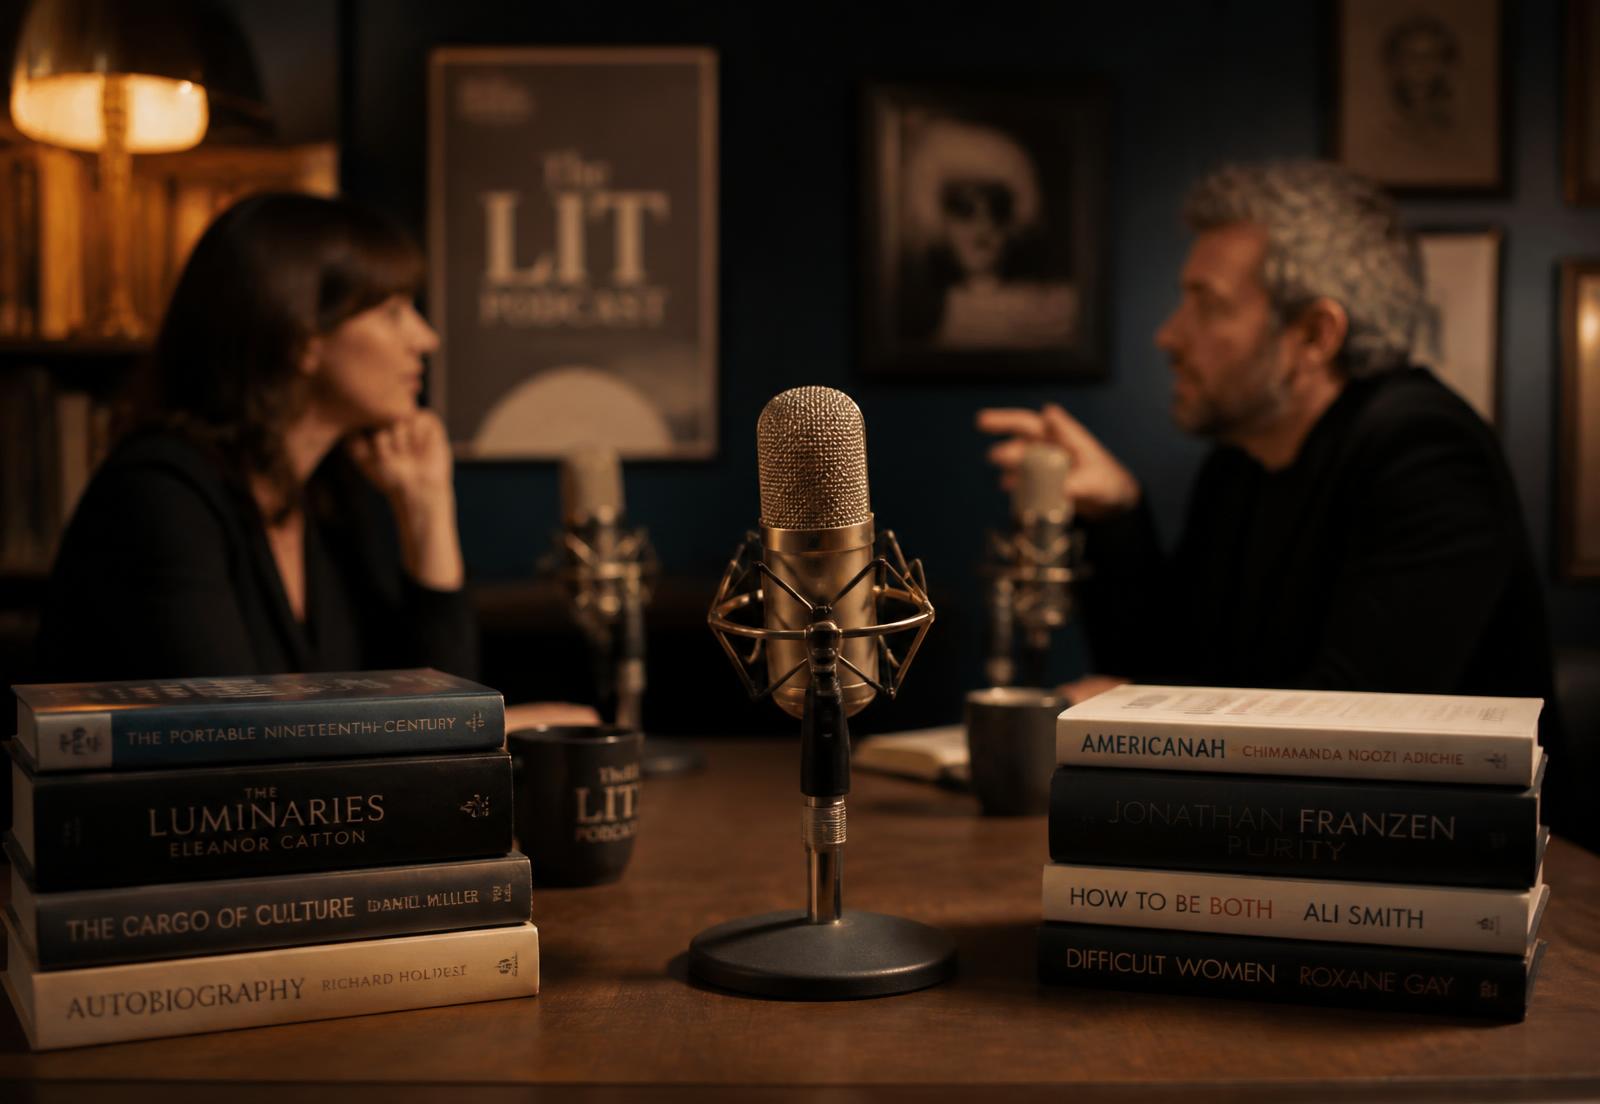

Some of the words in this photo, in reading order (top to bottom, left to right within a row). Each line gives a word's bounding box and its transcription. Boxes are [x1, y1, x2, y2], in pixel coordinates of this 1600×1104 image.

[480, 189, 670, 285] LIT
[128, 731, 161, 745] THE
[169, 727, 256, 745] PORTABLE
[1081, 733, 1225, 759] AMERICANAH
[1348, 750, 1397, 763] NGOZI
[1402, 751, 1465, 766] ADICHIE
[243, 786, 278, 798] THE
[575, 784, 640, 823] LIT
[149, 795, 384, 837] LUMINARIES
[1108, 800, 1285, 834] JONATHAN
[1300, 808, 1457, 841] FRANZEN
[169, 837, 272, 858] ELEANOR
[280, 828, 367, 850] CATTON
[1226, 833, 1347, 864] PURITY
[66, 918, 115, 943] THE
[122, 911, 209, 938] CARGO
[216, 906, 248, 929] OF
[255, 897, 355, 926] CULTURE
[1070, 887, 1128, 908] HOW
[1136, 891, 1166, 911] TO
[1176, 894, 1201, 914] BE
[1210, 897, 1273, 919] BOTH
[1303, 903, 1339, 924] ALI
[1348, 905, 1424, 929] SMITH
[1066, 948, 1167, 975] DIFFICULT
[1175, 956, 1277, 985] WOMEN
[1299, 965, 1397, 993] ROXANE
[1403, 974, 1456, 997] GAY
[66, 978, 306, 1020] AUTOBIOGRAPHY
[322, 972, 393, 992] RICHARD
